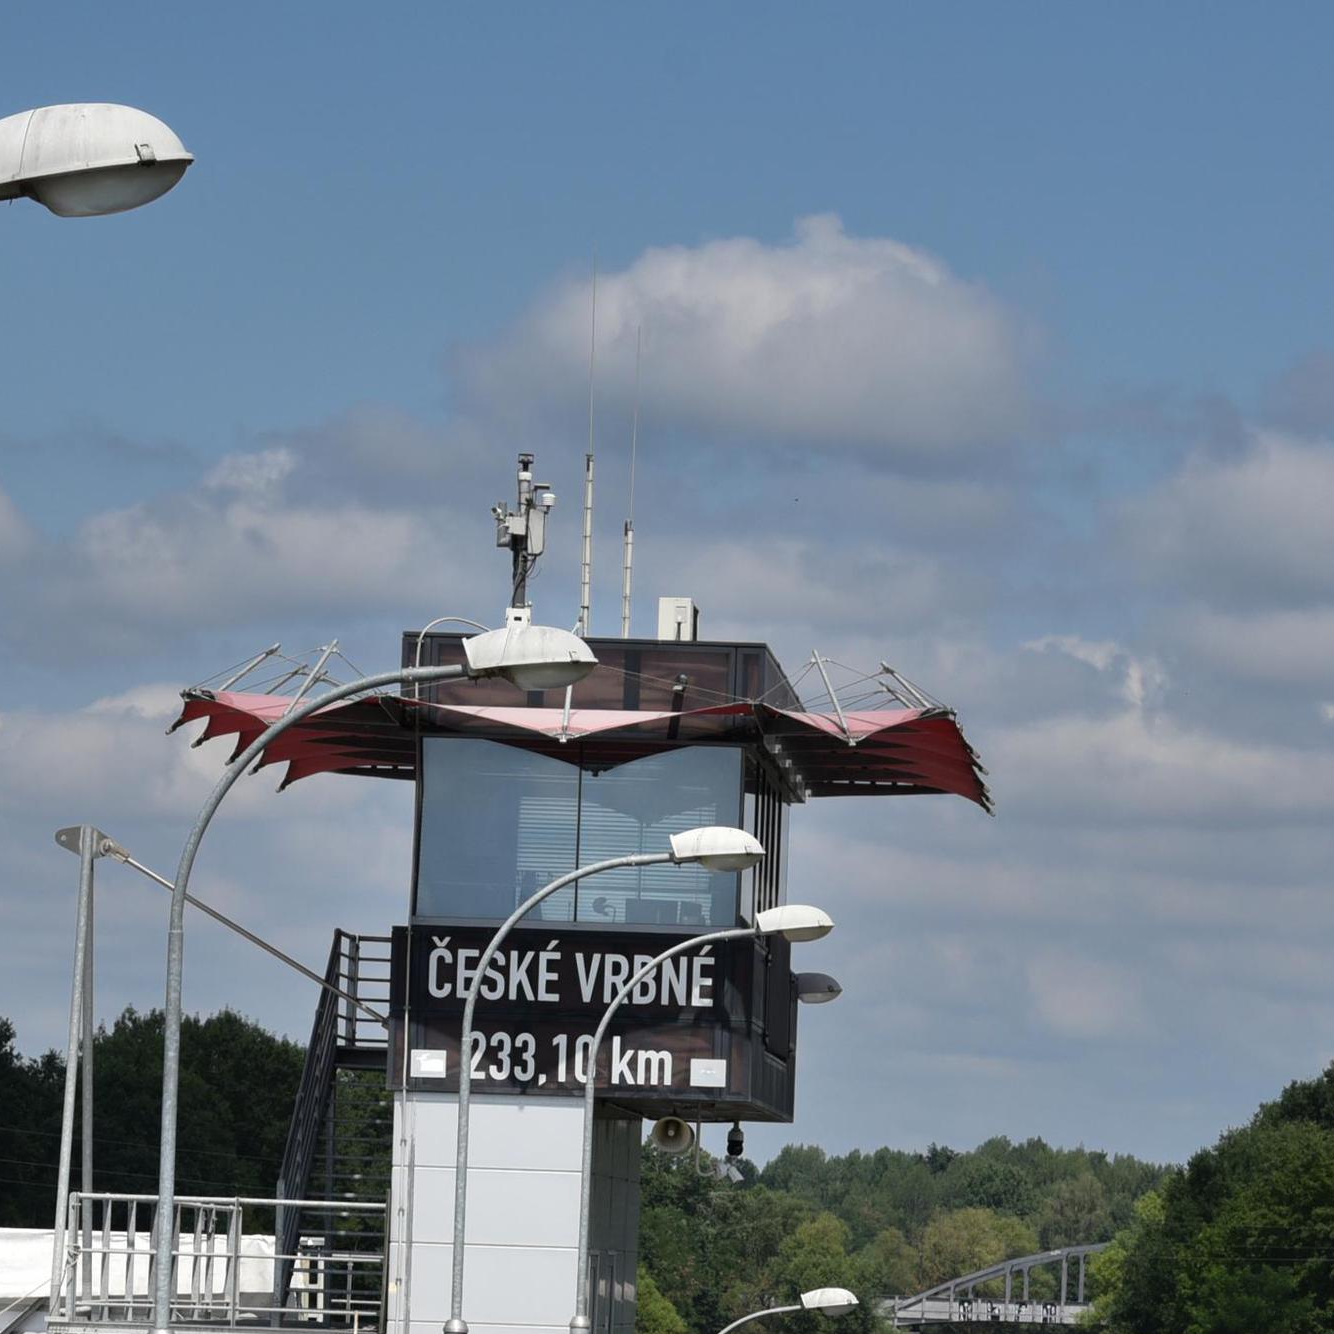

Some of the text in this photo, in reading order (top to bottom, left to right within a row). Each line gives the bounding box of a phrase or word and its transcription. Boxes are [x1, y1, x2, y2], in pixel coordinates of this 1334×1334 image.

[428, 937, 715, 1007] ČESKÉ VRBNÉ
[469, 1032, 673, 1086] 233,10 km
